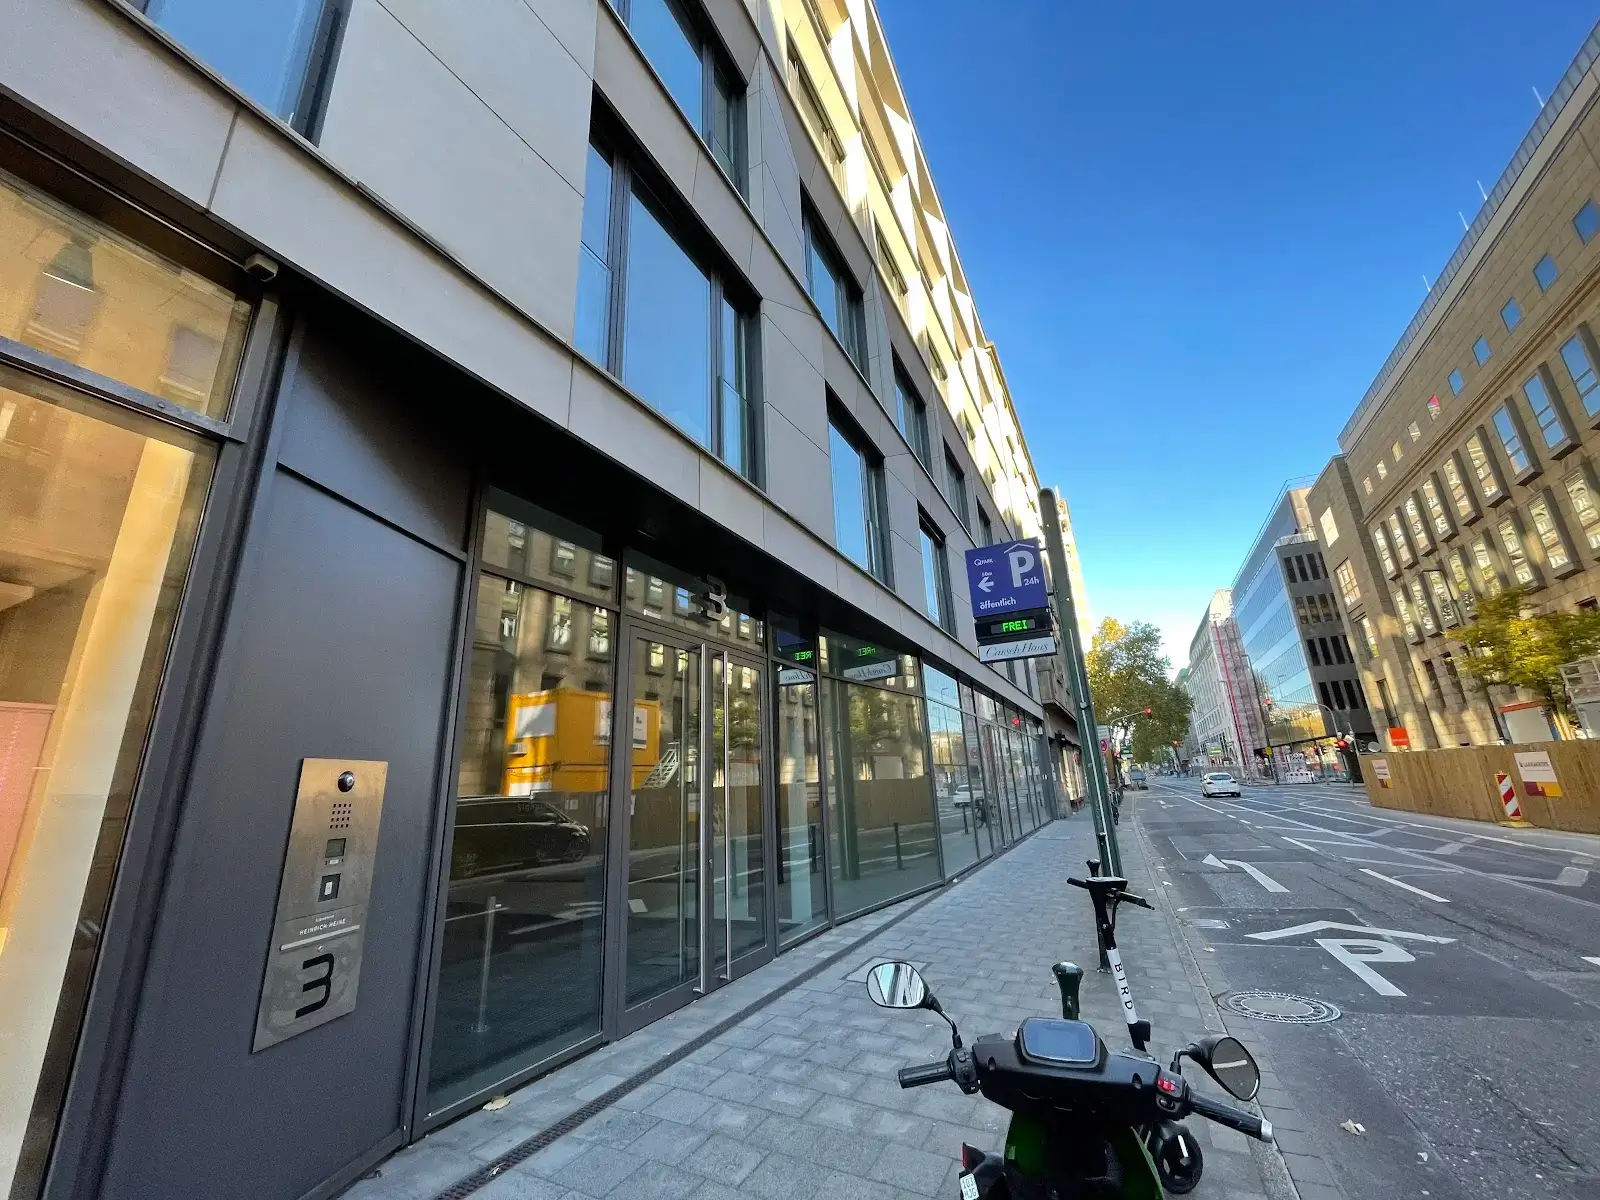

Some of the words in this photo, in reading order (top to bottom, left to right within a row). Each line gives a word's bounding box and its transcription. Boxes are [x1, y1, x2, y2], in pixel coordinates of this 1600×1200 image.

[1009, 550, 1035, 588] P
[1024, 576, 1040, 586] 24h
[979, 596, 1017, 610] öffentlich
[1002, 619, 1028, 632] FREI
[299, 923, 328, 935] HEINRICH
[329, 917, 346, 928] HEINE
[1314, 938, 1416, 997] P
[294, 952, 335, 1019] 3
[1114, 964, 1134, 1010] BIRD
